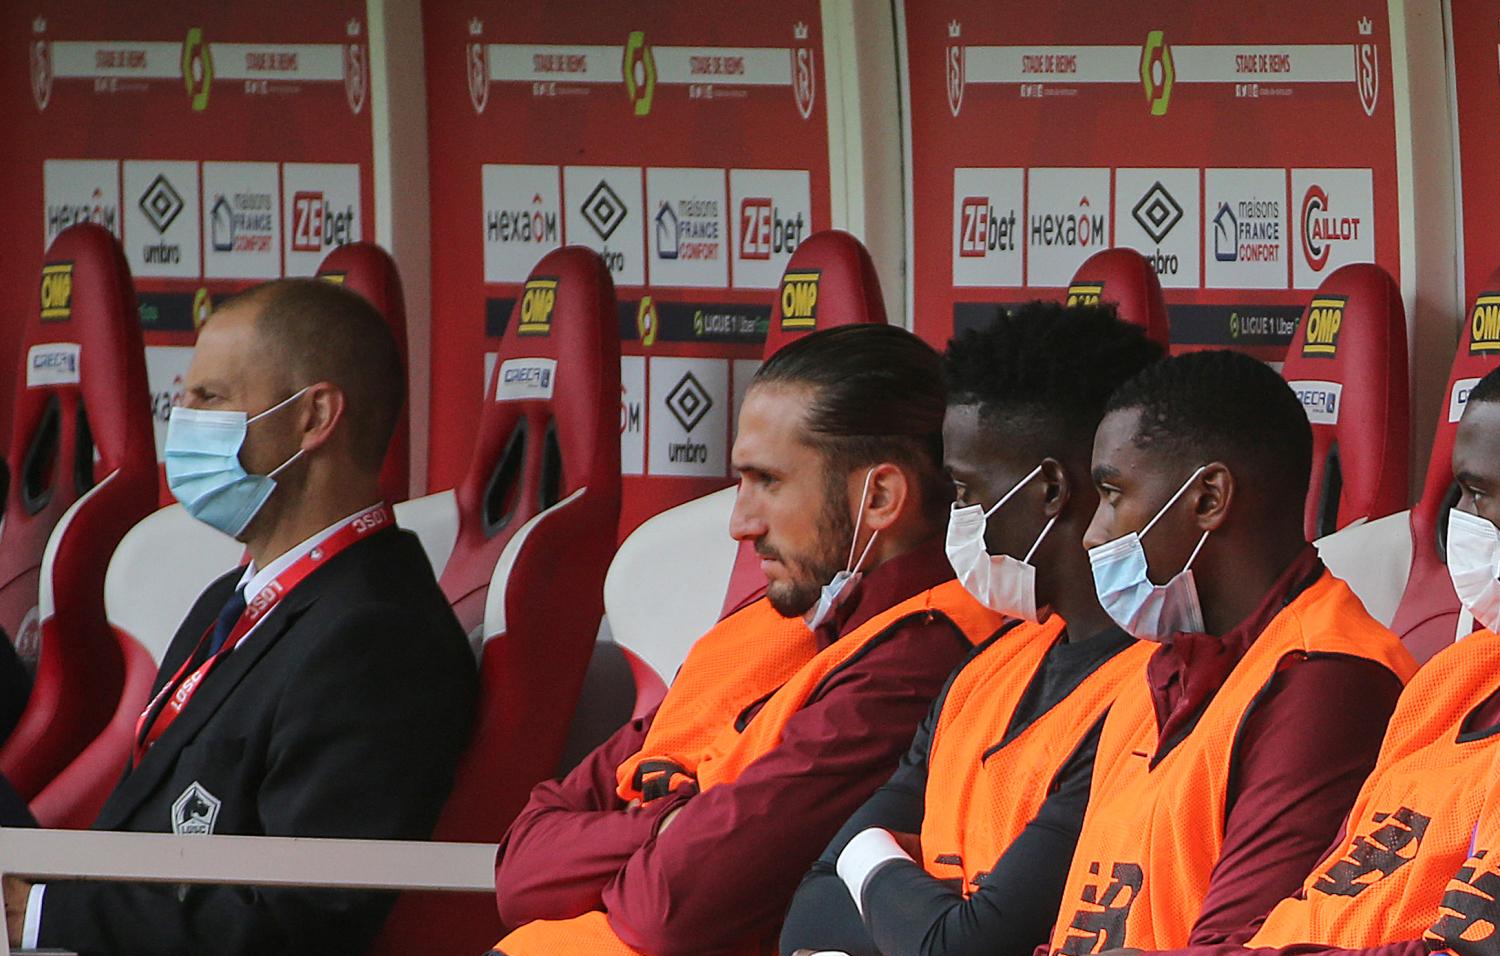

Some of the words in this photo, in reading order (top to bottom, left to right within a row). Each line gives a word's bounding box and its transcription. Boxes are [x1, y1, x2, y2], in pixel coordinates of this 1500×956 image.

[1022, 54, 1043, 73] STADE
[1045, 54, 1054, 73] DE
[1056, 54, 1076, 73] REIMS
[1236, 54, 1257, 72] STADE
[1259, 54, 1268, 72] DE
[1269, 54, 1290, 72] REIMS
[678, 198, 718, 218] maisons
[1238, 197, 1279, 218] maisons
[233, 213, 272, 231] FRANCE
[678, 221, 718, 240] FRANCE
[960, 196, 1016, 258] ZEbet
[1240, 224, 1280, 241] FRANCE
[143, 242, 182, 264] umbro
[233, 235, 272, 252] CONFORT
[678, 242, 719, 260] CONFORT
[1240, 244, 1280, 262] CONFORT
[521, 287, 555, 323] OMP
[782, 282, 817, 318] OMP
[1241, 316, 1268, 335] LIGUE
[1276, 316, 1294, 334] Uber
[1306, 308, 1342, 343] OMP
[668, 439, 707, 464] umbro
[245, 581, 284, 617] LOSC
